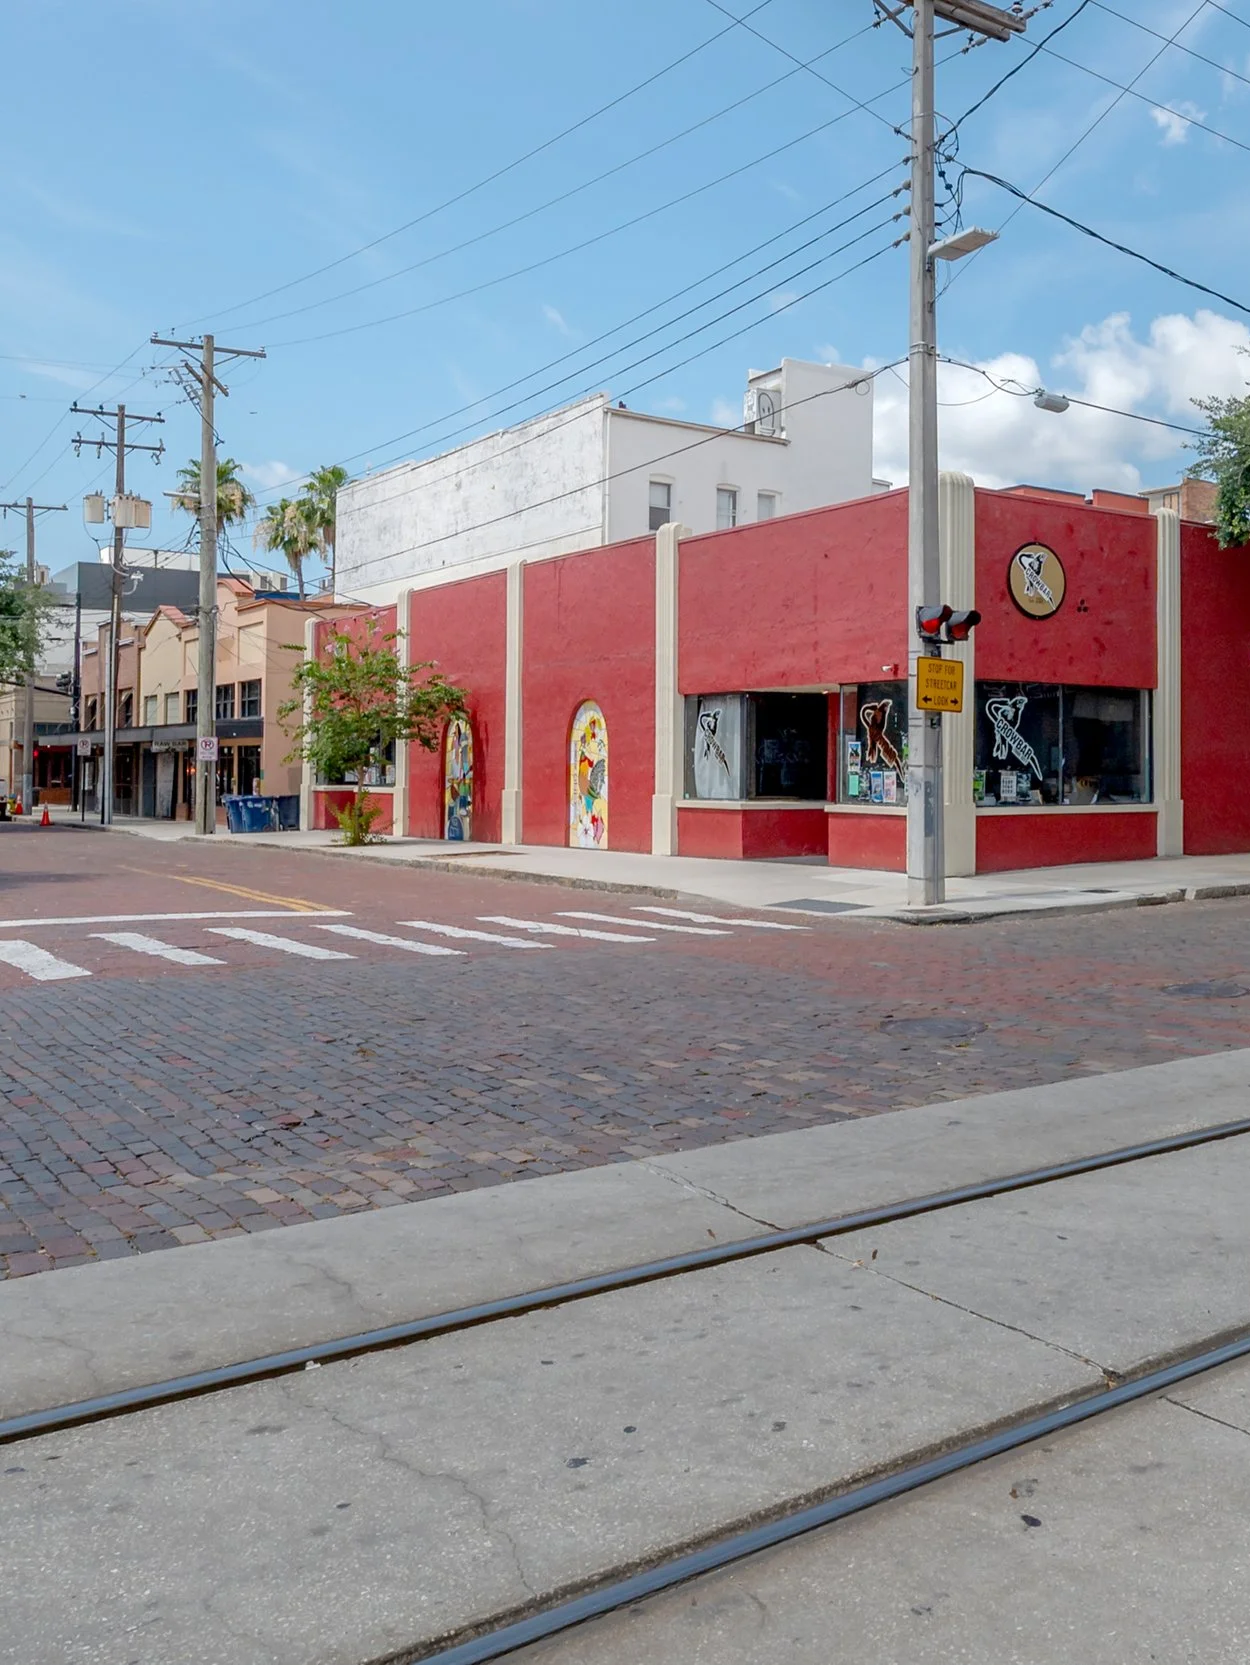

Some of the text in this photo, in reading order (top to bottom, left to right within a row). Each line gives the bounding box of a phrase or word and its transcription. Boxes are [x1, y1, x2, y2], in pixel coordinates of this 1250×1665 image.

[1025, 567, 1051, 599] CROWBAR
[928, 663, 956, 675] STOP FOR
[925, 678, 957, 690] STREETCAR
[933, 696, 949, 706] LOOK
[995, 717, 1033, 761] CROWBAR
